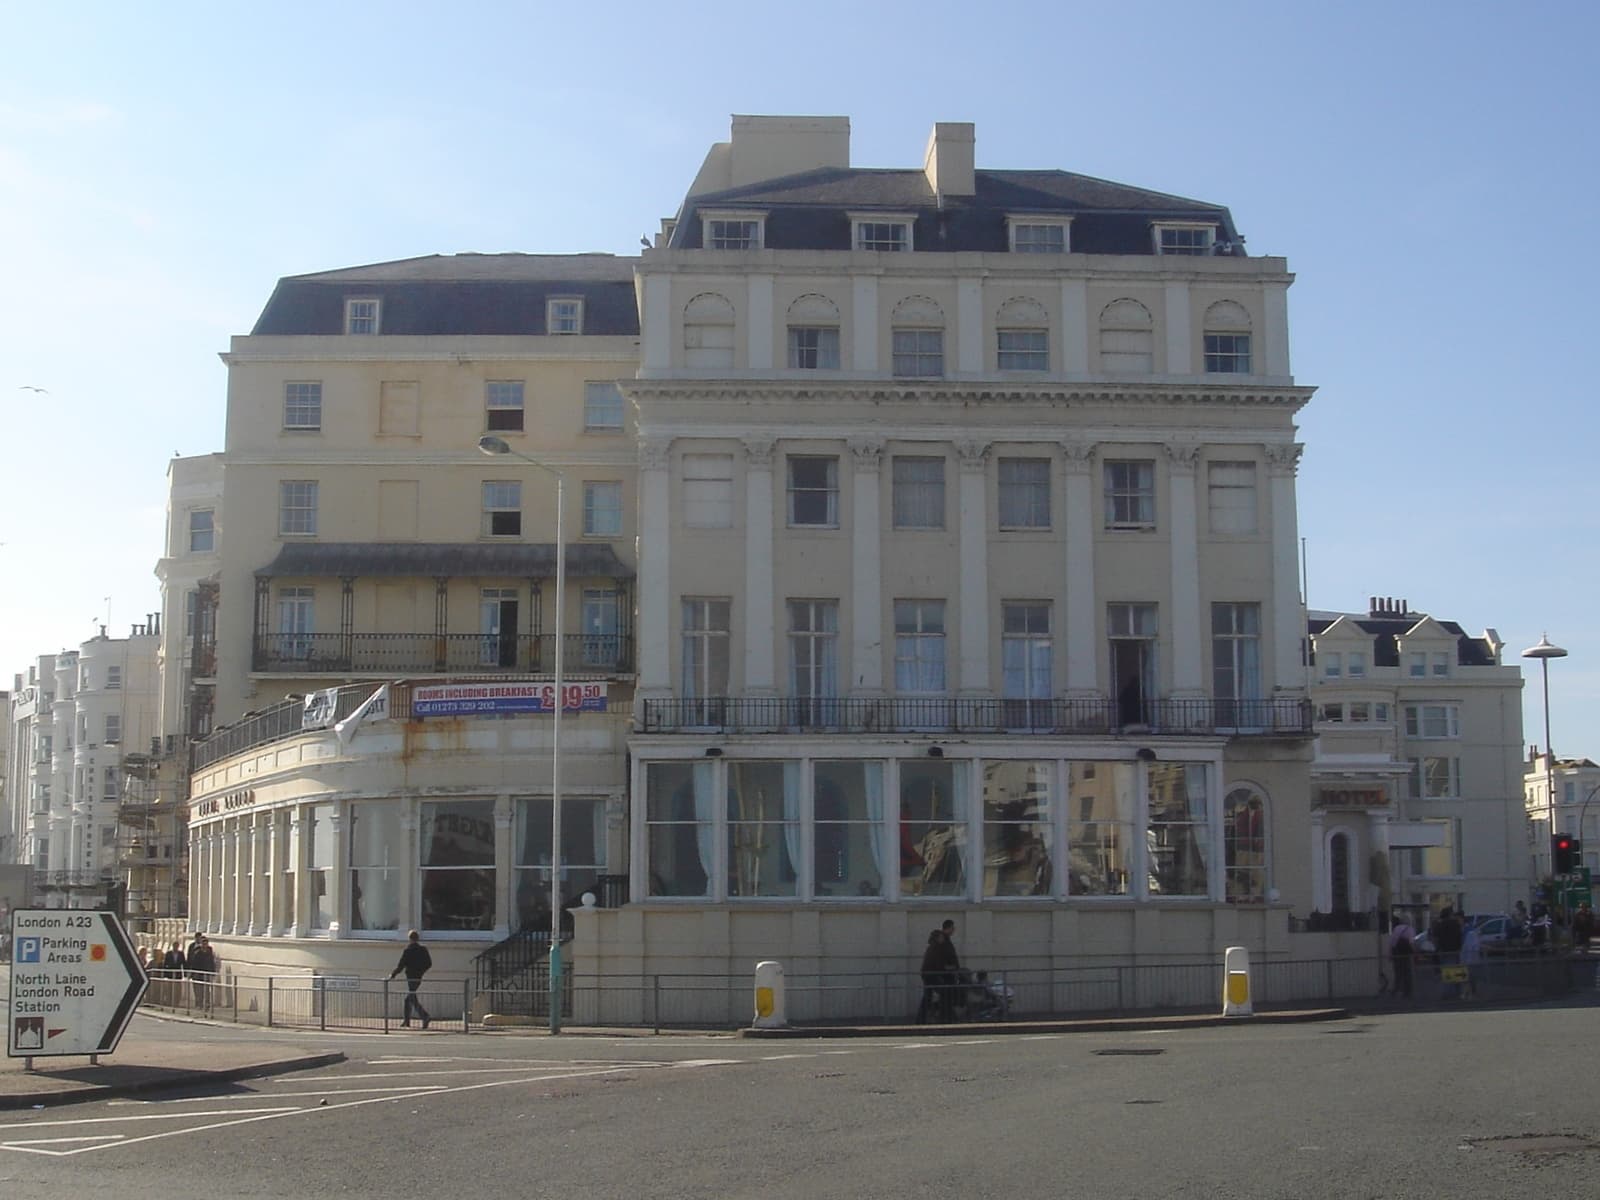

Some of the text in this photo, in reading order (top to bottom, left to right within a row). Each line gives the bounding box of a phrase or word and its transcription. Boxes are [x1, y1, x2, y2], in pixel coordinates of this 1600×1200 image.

[446, 688, 487, 698] INCLUDING
[490, 686, 537, 697] BREAKFAST
[416, 702, 431, 712] Call
[1321, 788, 1390, 805] HOTEL
[17, 916, 92, 928] London A23
[22, 937, 87, 961] P Parking
[47, 952, 82, 963] Areas
[15, 974, 87, 985] North Laine
[15, 985, 94, 998] London Road
[15, 1001, 60, 1012] Station
